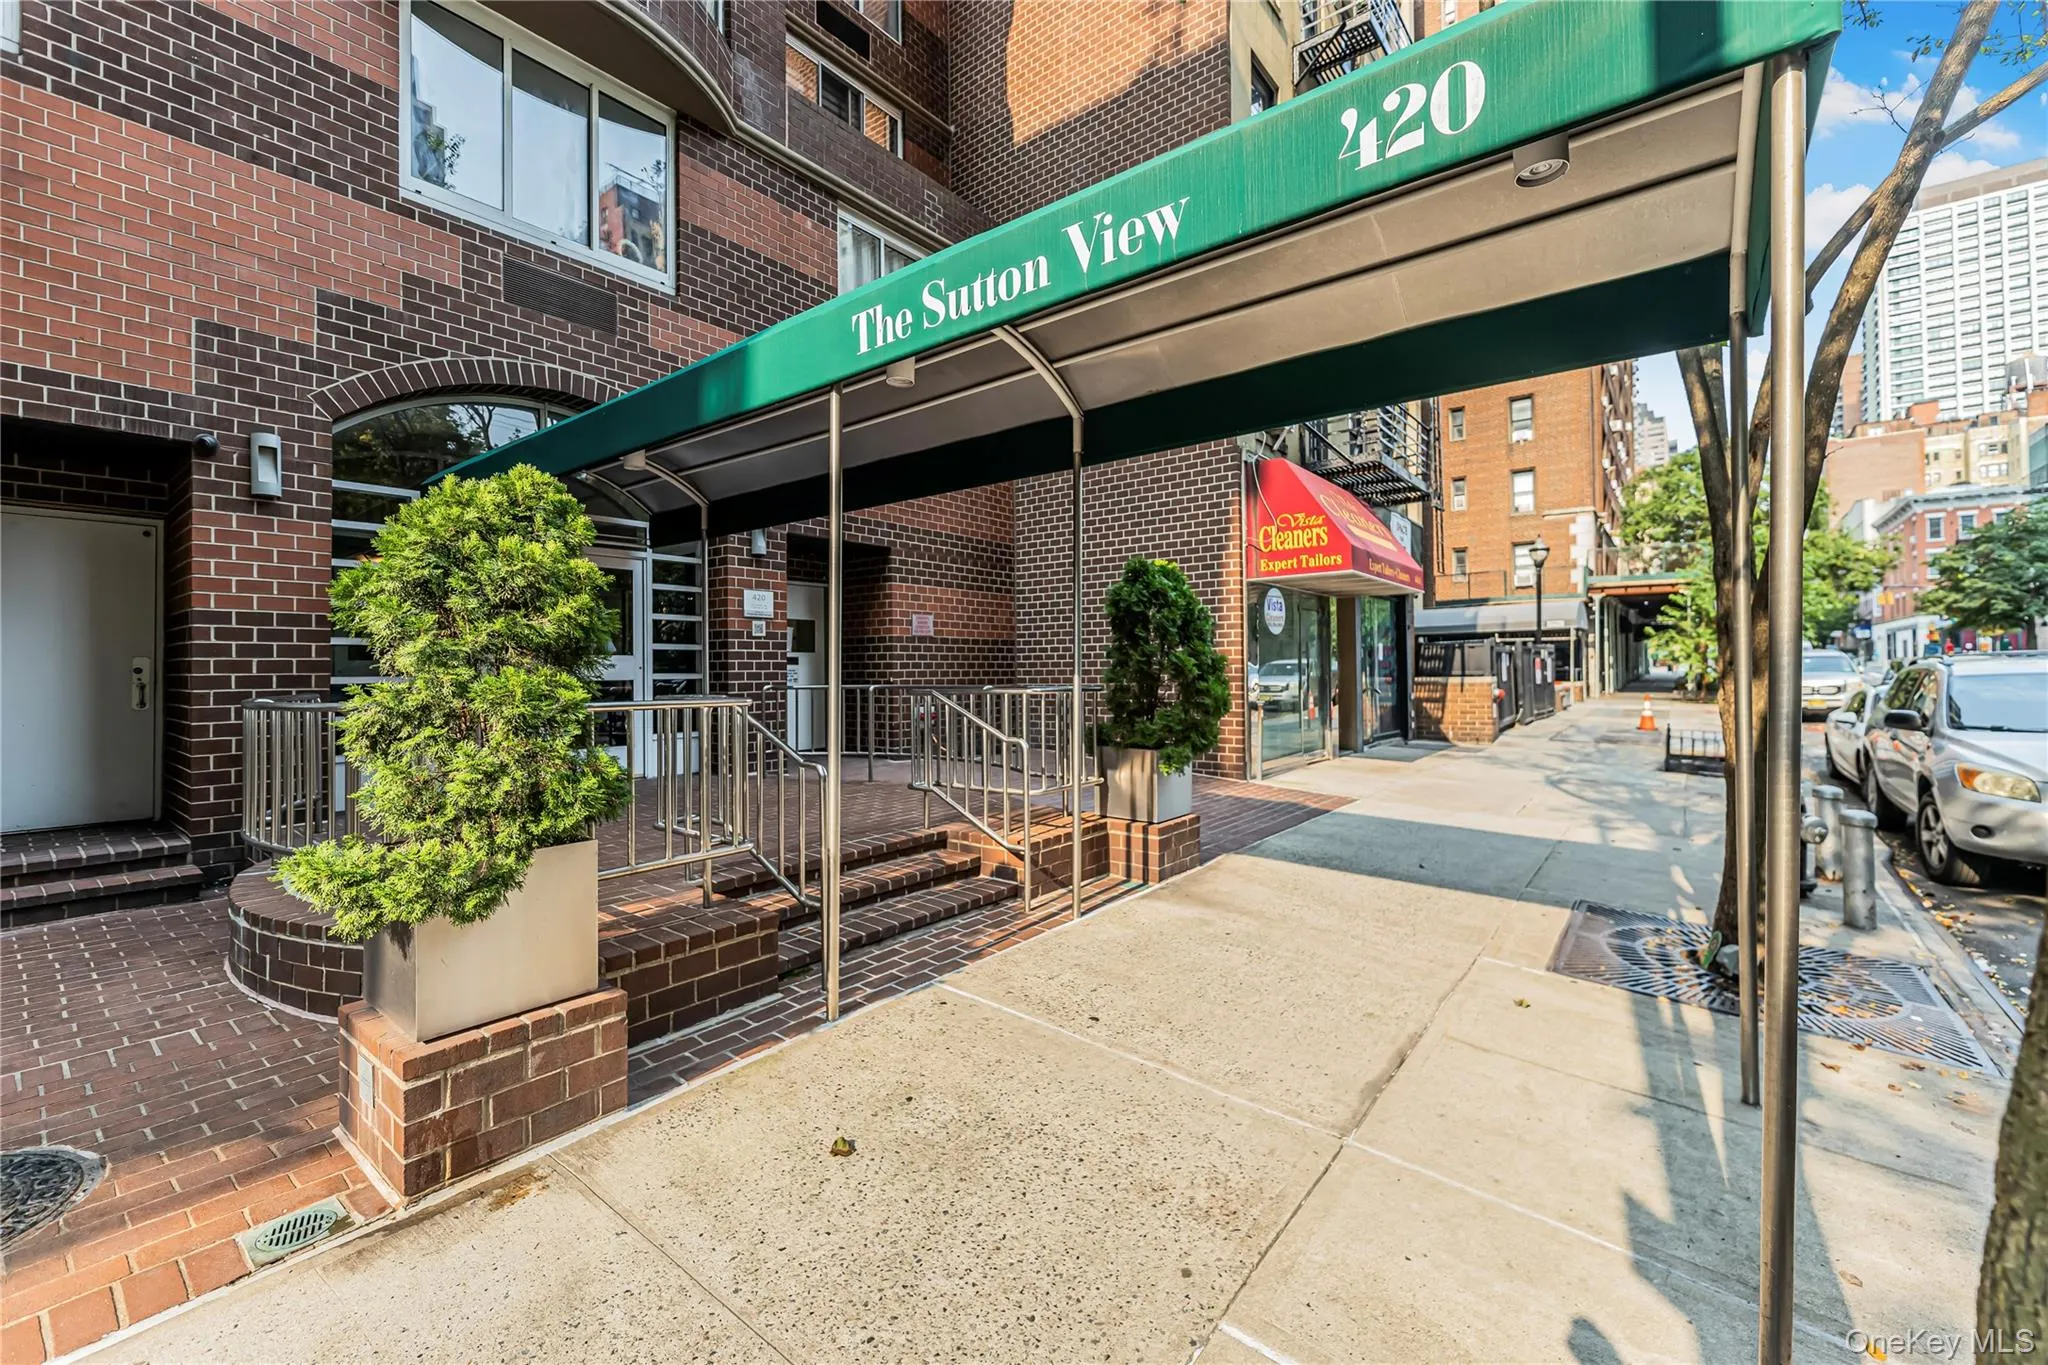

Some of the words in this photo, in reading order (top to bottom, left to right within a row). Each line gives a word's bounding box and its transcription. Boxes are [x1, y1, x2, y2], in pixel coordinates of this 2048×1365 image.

[1337, 60, 1486, 172] 420
[851, 303, 913, 356] The
[921, 255, 1051, 330] Sutton
[1061, 197, 1191, 275] View
[1276, 512, 1326, 528] Vista
[1259, 525, 1328, 553] Cleaners
[1260, 557, 1298, 573] Expert
[1300, 553, 1343, 569] Tailors
[752, 593, 766, 602] 420
[1267, 598, 1284, 612] Vista
